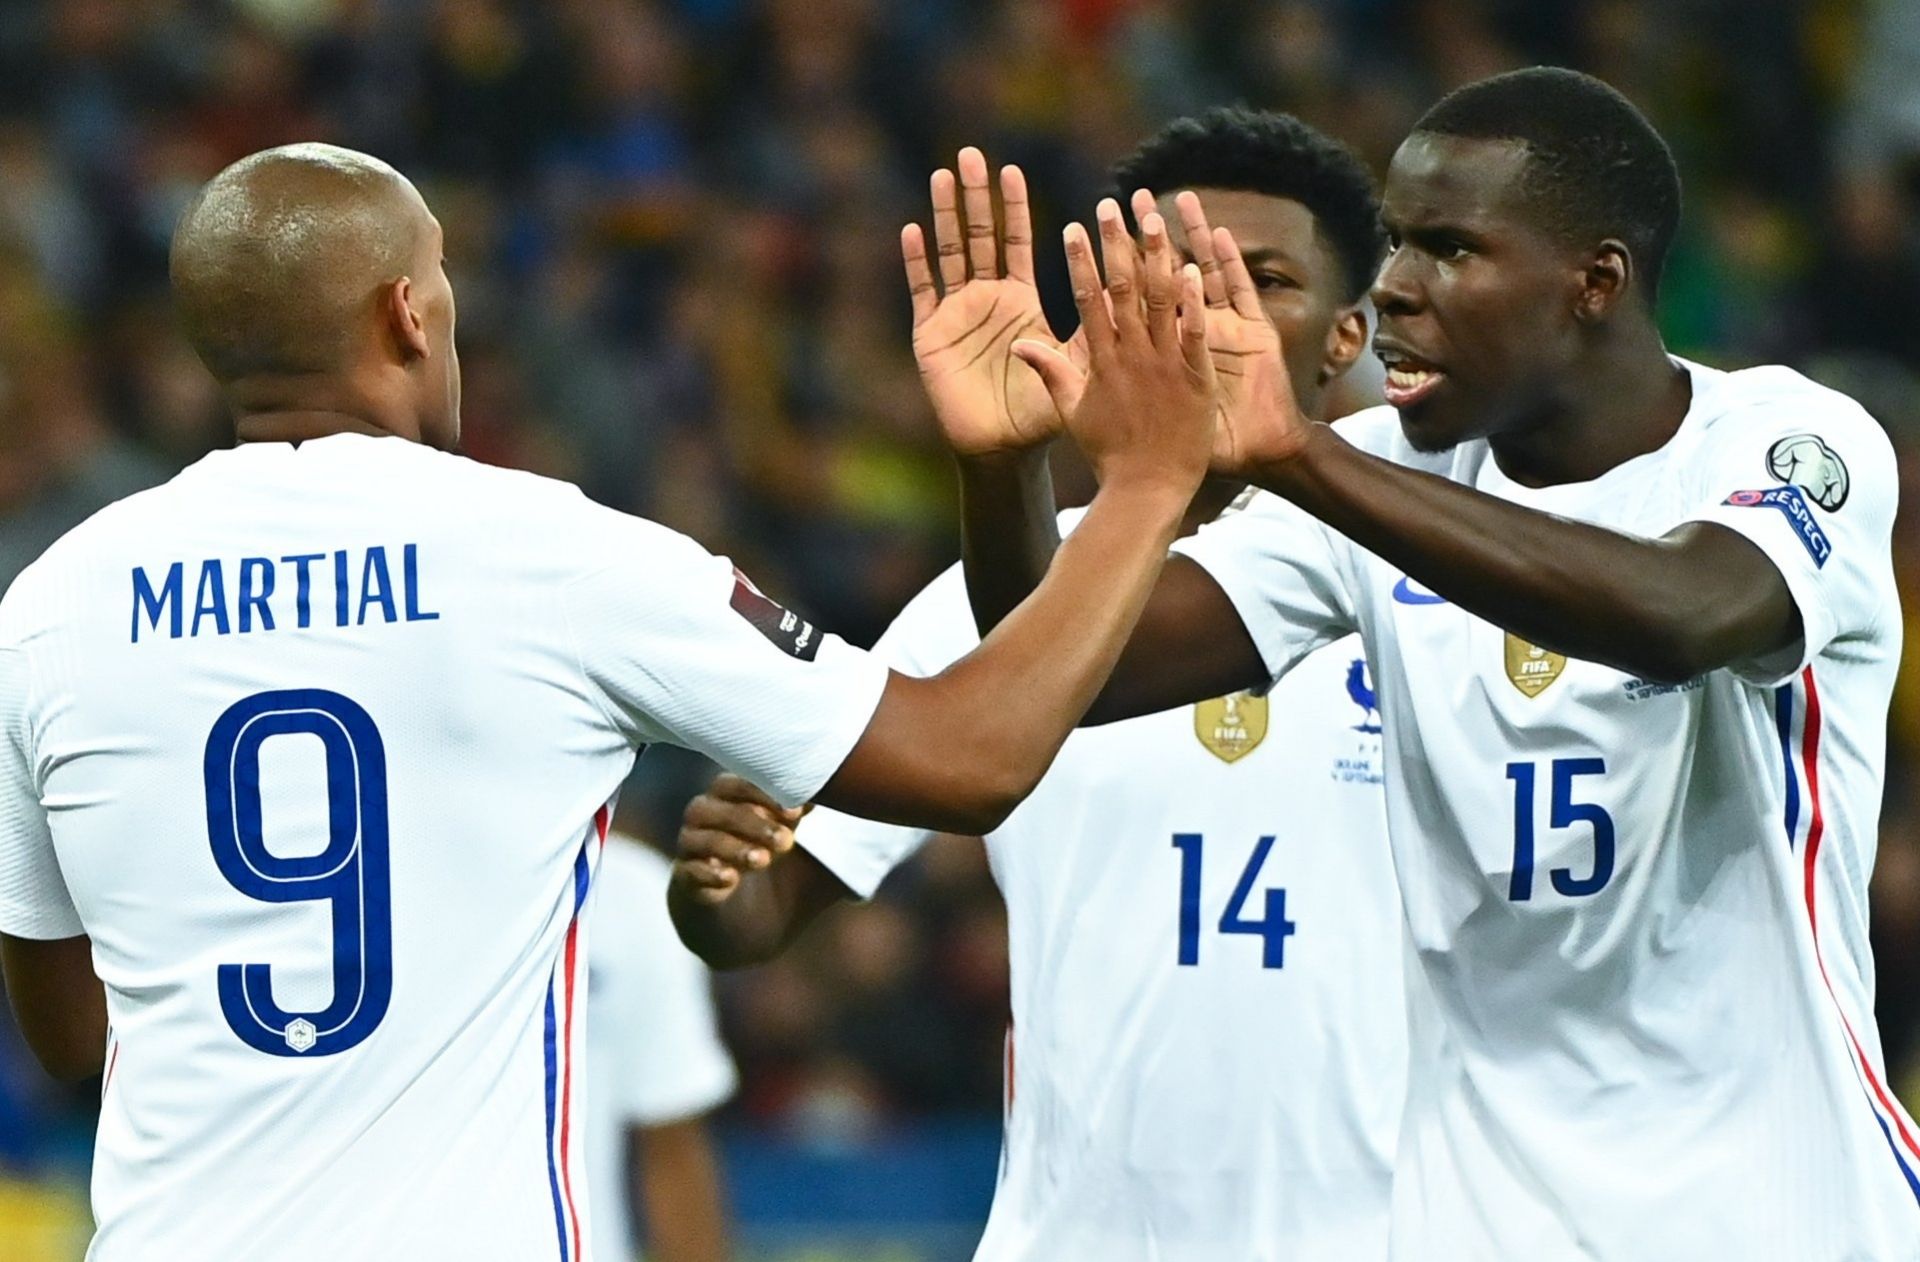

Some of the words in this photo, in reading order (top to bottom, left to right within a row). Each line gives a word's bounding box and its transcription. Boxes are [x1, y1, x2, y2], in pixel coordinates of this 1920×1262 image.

[1762, 490, 1830, 559] RESPECT
[131, 543, 440, 643] MARTIAL
[1521, 660, 1550, 674] FIFA
[1214, 727, 1248, 739] FIFA
[204, 688, 393, 1058] 9
[1506, 757, 1615, 902] 15
[1172, 833, 1296, 969] 14
